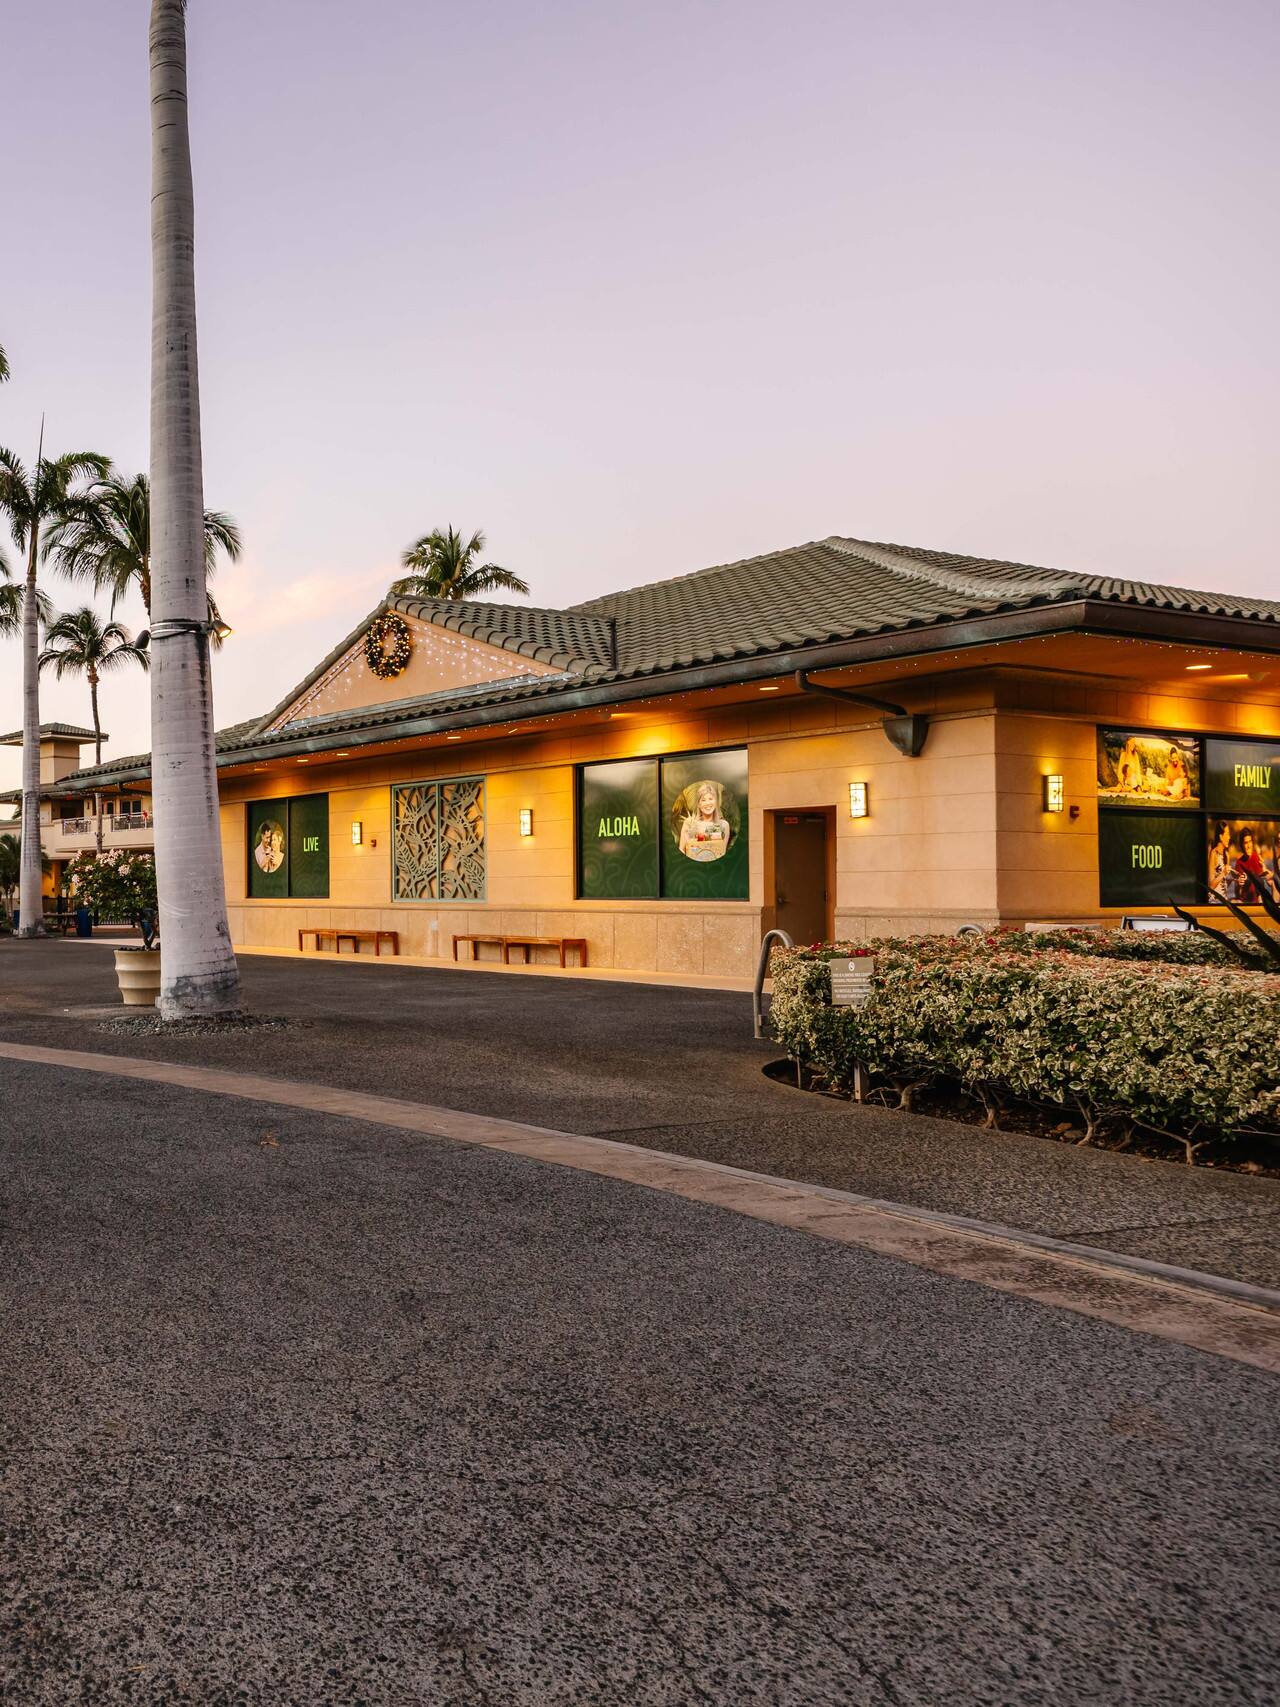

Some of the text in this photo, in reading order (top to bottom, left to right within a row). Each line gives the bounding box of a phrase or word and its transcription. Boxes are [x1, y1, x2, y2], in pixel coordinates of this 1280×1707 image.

[1234, 764, 1271, 789] FAMILY
[598, 815, 640, 838] ALOHA
[303, 836, 319, 852] LIVE
[1131, 845, 1162, 869] FOOD
